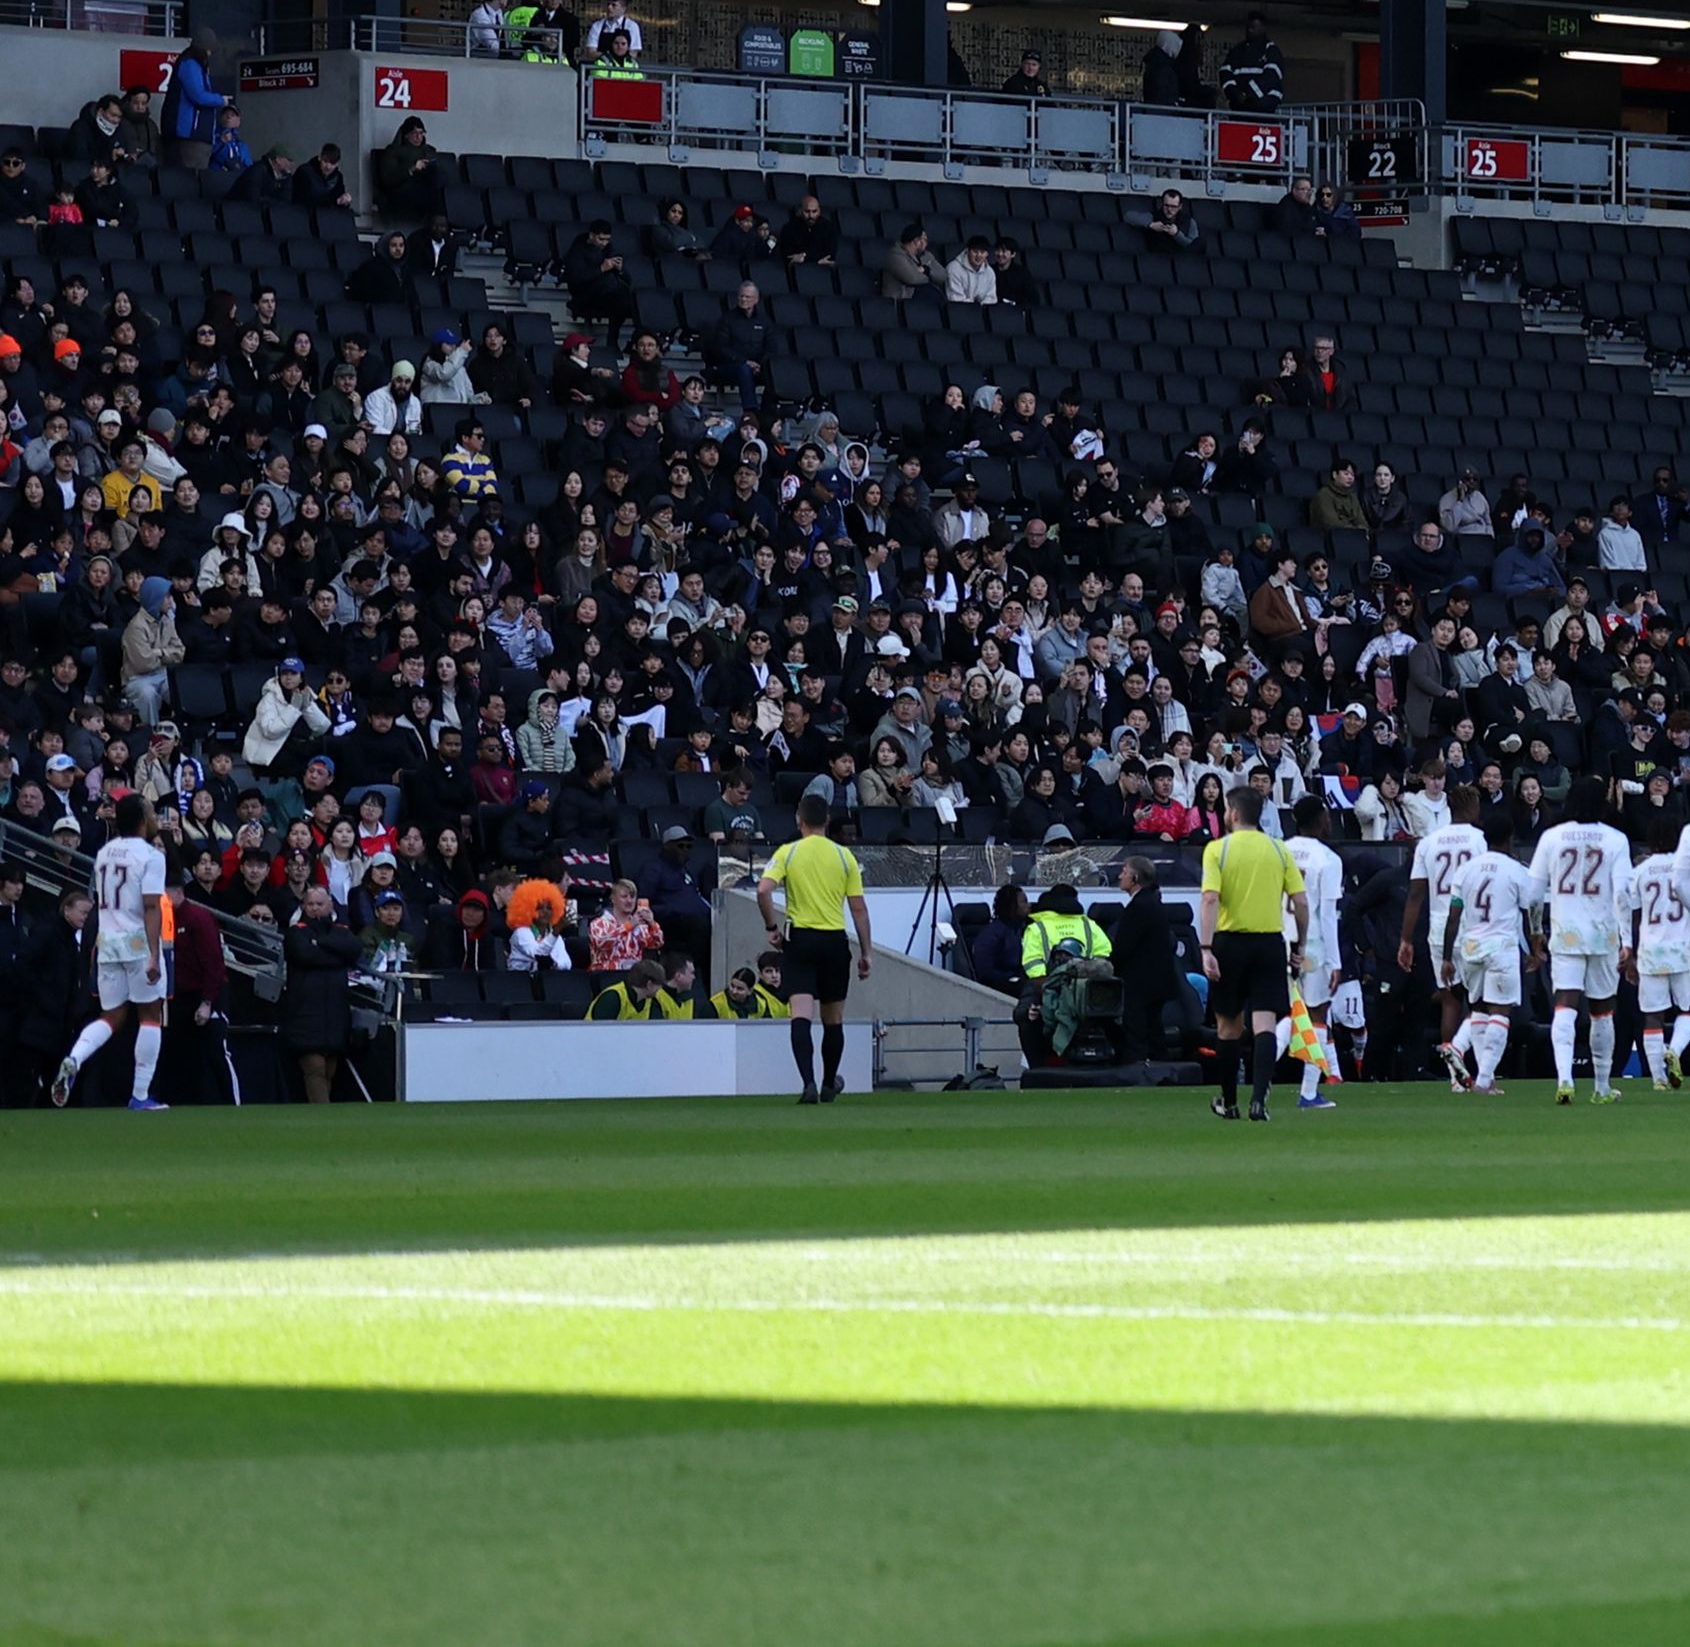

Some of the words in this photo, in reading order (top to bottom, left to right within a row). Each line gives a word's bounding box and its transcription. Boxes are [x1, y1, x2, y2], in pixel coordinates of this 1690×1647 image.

[258, 77, 278, 87] Block
[387, 69, 403, 78] Aisle
[379, 77, 412, 108] 24
[1251, 134, 1278, 163] 25
[1373, 142, 1391, 150] Block
[1368, 150, 1396, 177] 22
[1470, 149, 1497, 177] 25
[1559, 848, 1603, 895] 22
[99, 865, 127, 910] 17
[1475, 877, 1493, 923] 4
[1646, 879, 1684, 925] 25
[1345, 997, 1359, 1015] 11
